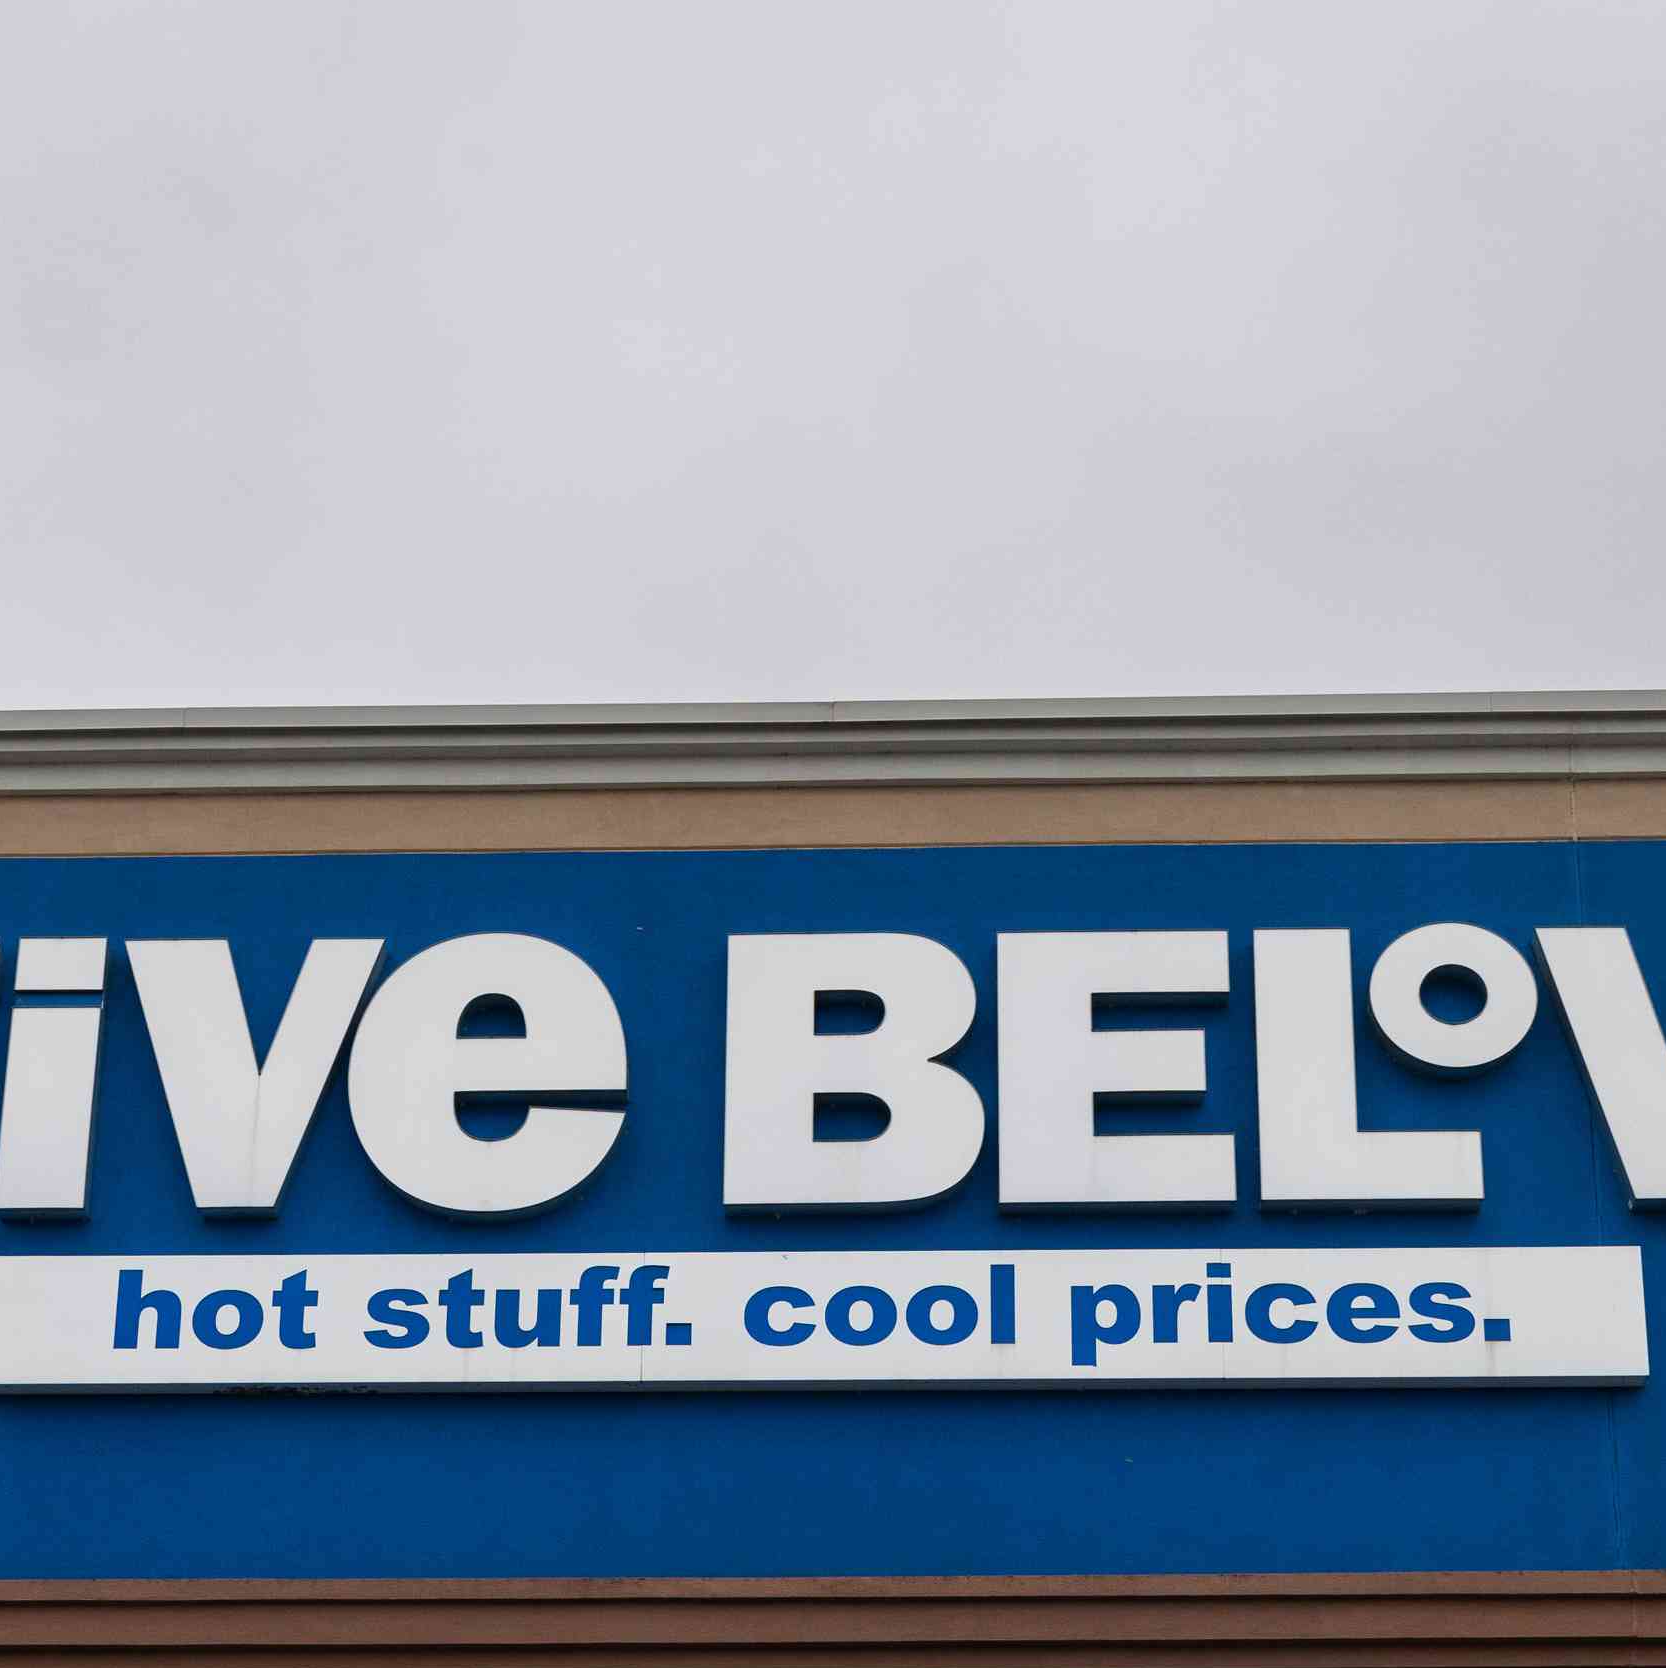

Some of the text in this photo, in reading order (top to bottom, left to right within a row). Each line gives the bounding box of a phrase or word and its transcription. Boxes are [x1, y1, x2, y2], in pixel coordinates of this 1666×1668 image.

[114, 1262, 1512, 1369] hot stuff. cool prices.
